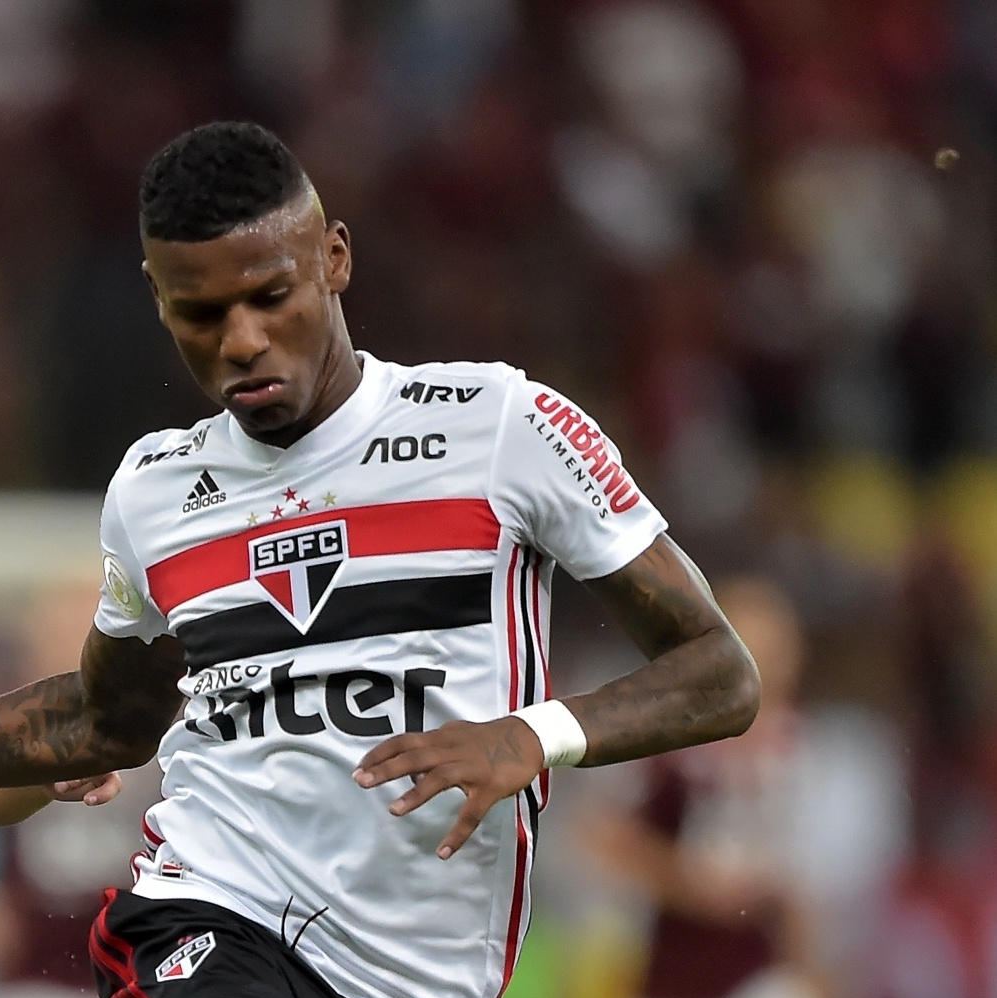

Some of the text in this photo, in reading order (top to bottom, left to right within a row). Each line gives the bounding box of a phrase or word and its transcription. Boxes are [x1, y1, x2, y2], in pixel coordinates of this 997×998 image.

[524, 412, 609, 519] ALIMENTOS
[182, 491, 227, 514] adidas
[257, 528, 339, 566] SPFC
[193, 664, 262, 696] BANCO
